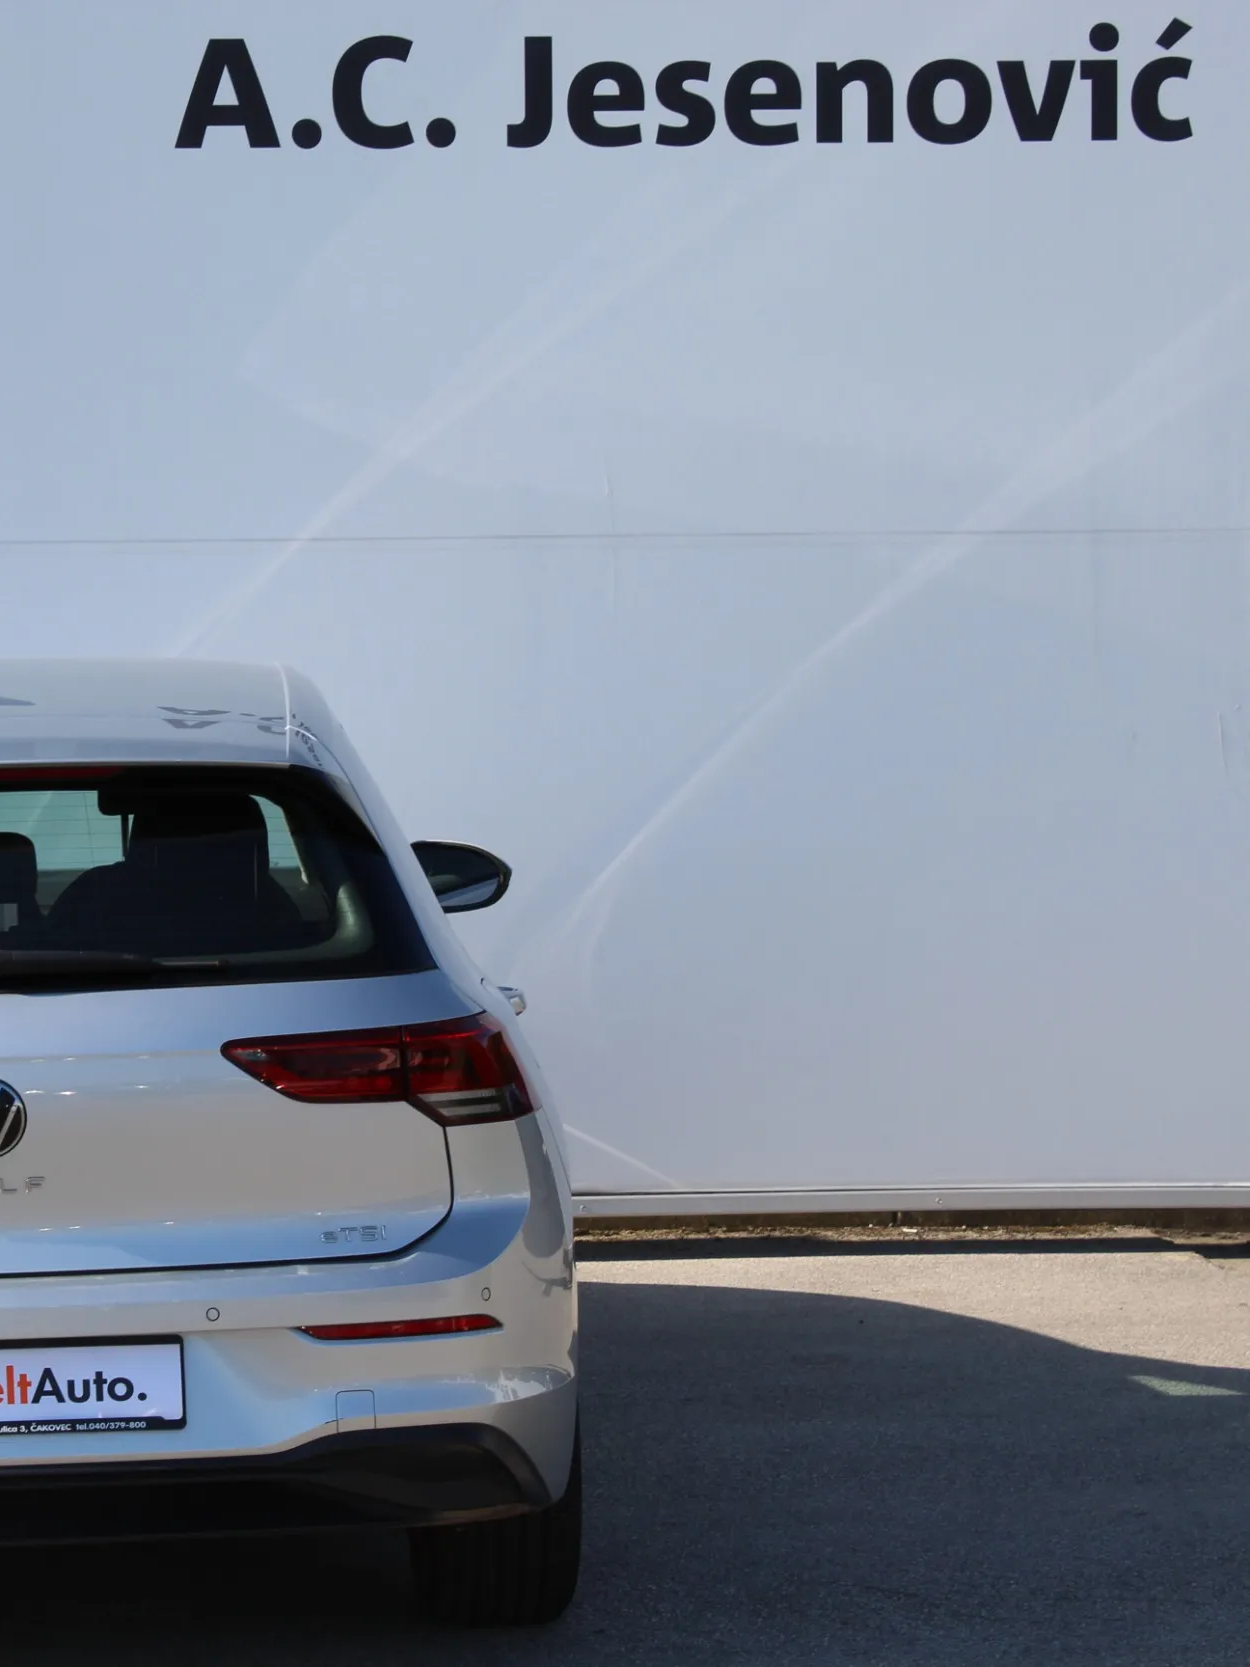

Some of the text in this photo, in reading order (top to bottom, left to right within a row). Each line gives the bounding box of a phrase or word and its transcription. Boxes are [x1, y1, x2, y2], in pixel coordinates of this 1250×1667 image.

[174, 17, 1193, 150] A.C. Jesenović
[30, 1422, 72, 1432] ČAKOVEC
